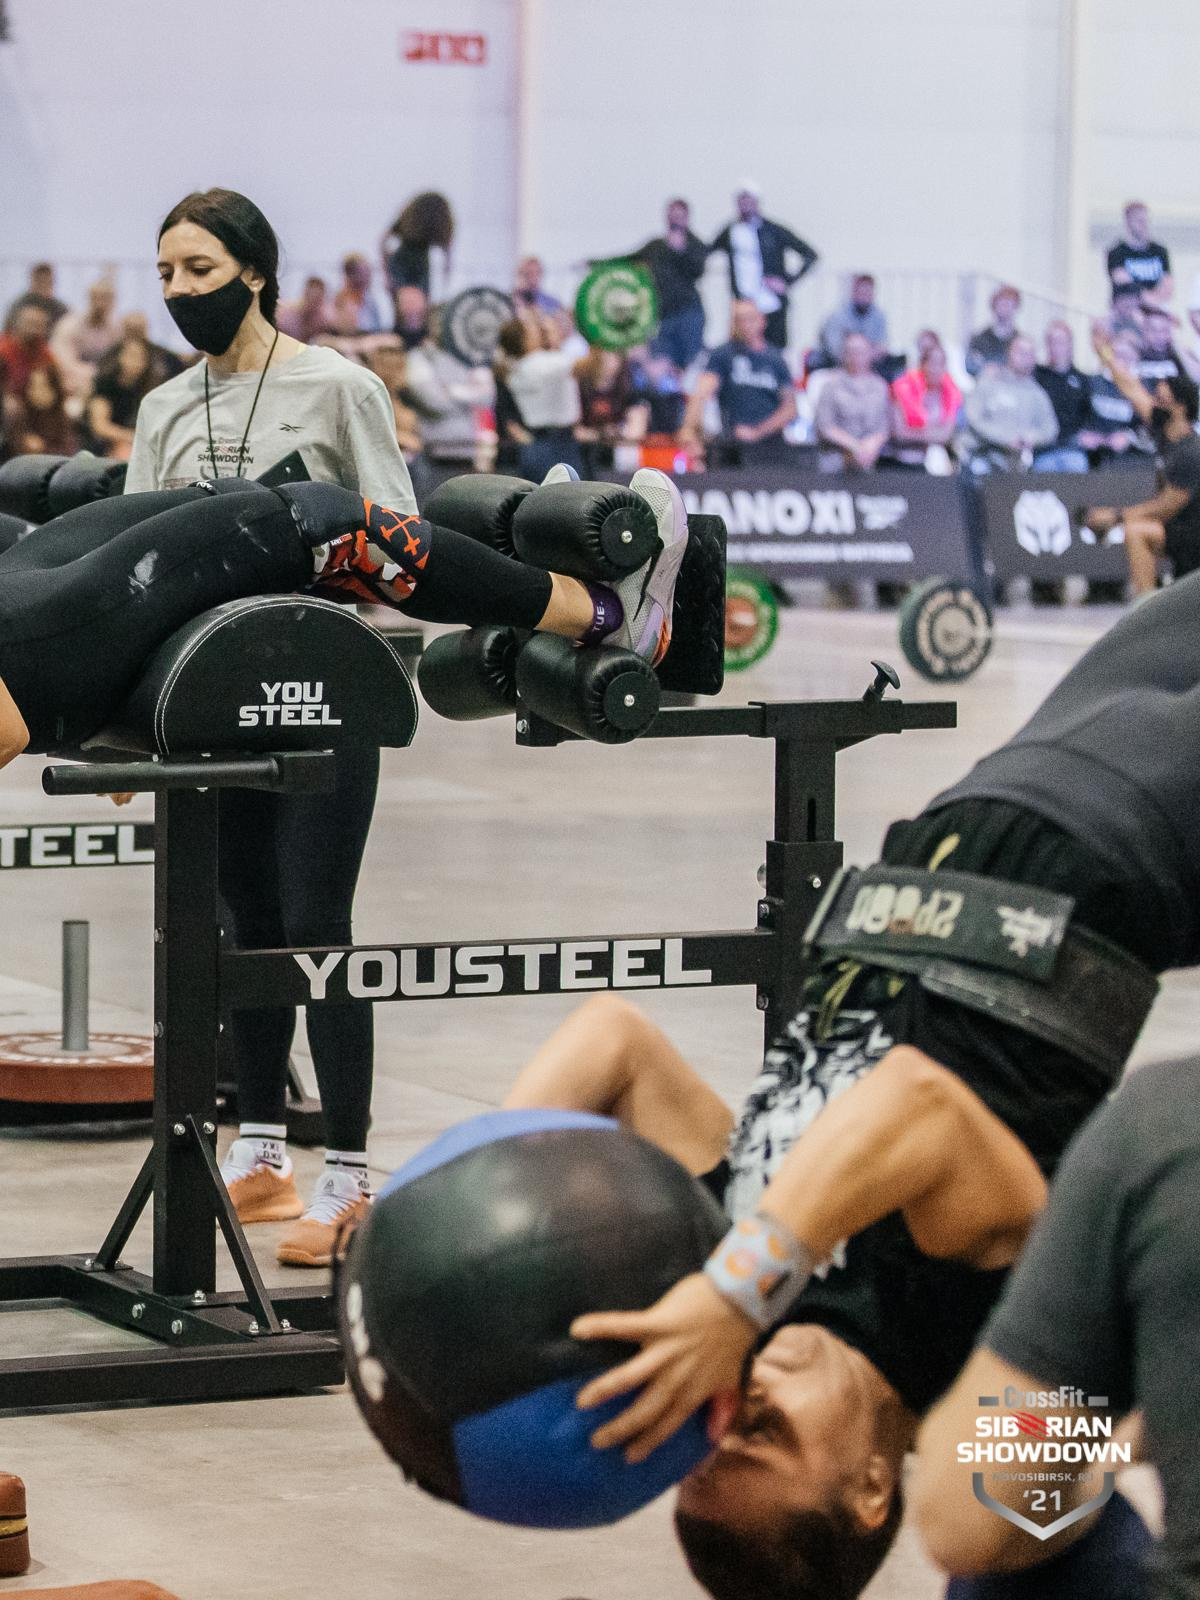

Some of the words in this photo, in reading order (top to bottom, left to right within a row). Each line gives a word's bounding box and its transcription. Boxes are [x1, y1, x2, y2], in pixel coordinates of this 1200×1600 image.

[261, 681, 324, 704] YOU
[238, 704, 342, 727] STEEL
[292, 938, 713, 1001] YOUSTEEL
